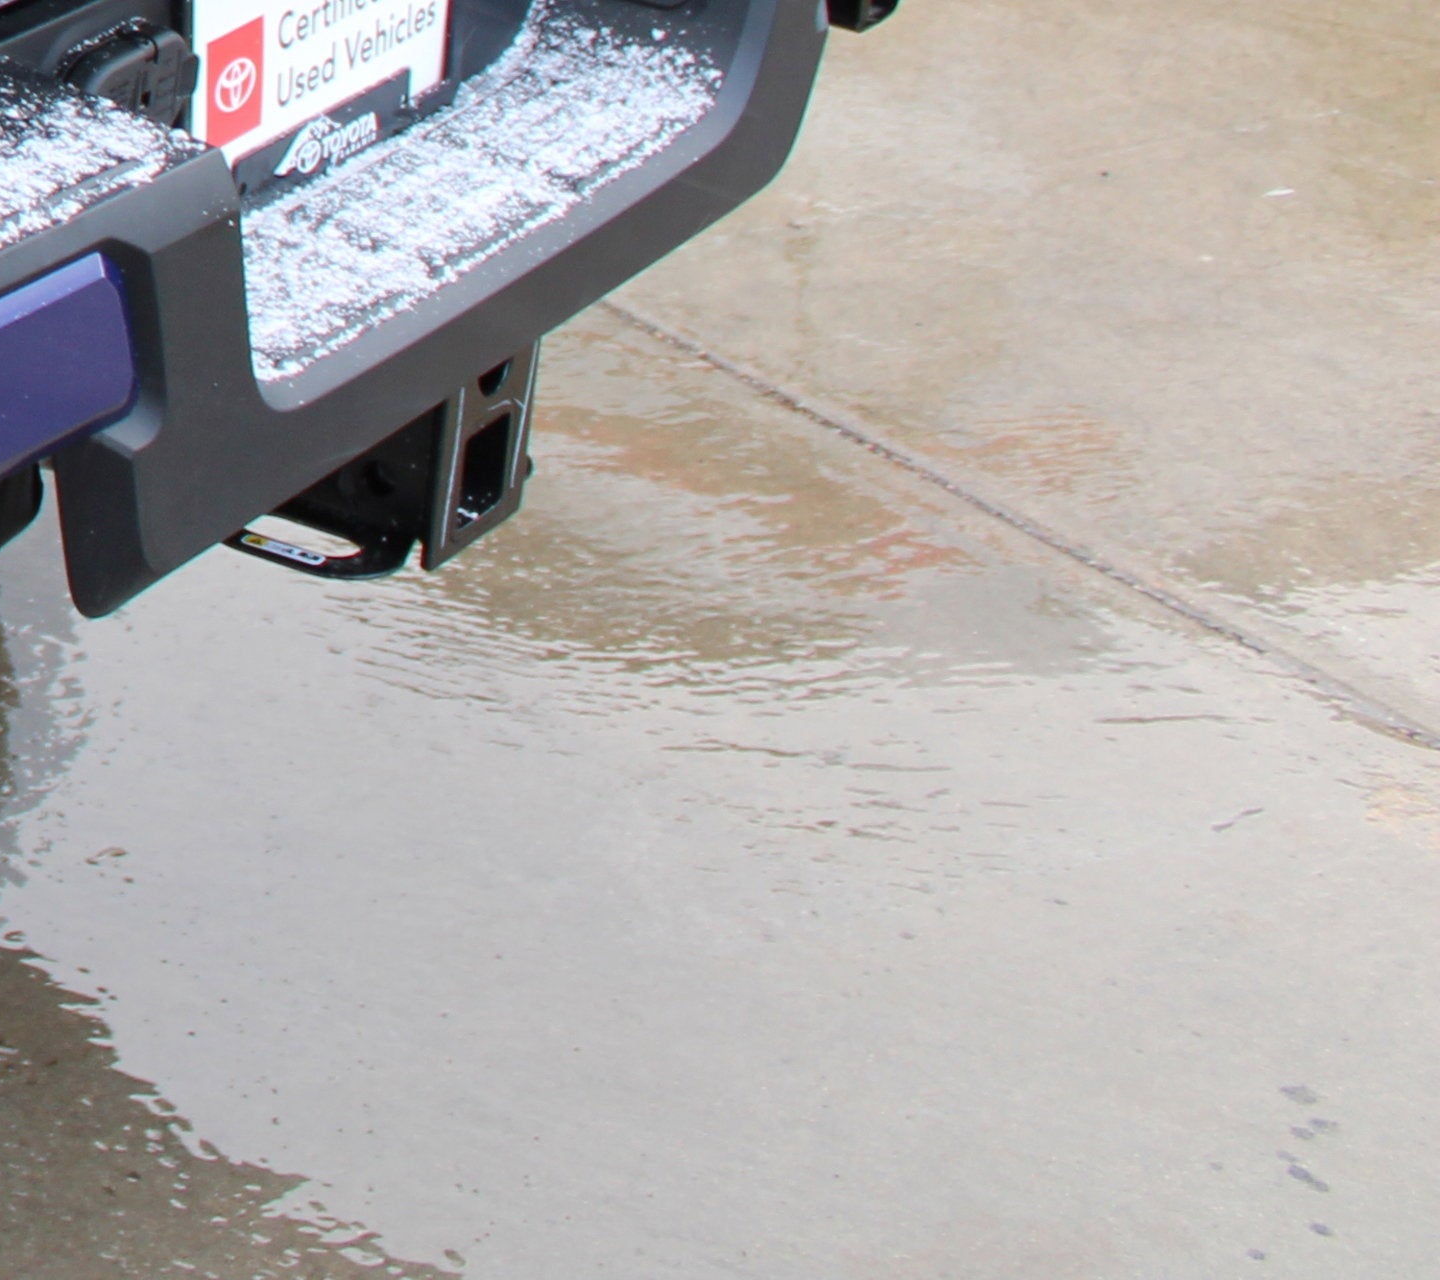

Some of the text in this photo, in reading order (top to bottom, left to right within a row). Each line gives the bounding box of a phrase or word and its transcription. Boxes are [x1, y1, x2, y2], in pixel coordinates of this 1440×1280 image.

[277, 0, 437, 108] Used Vehicles
[321, 111, 378, 159] TOYOTA
